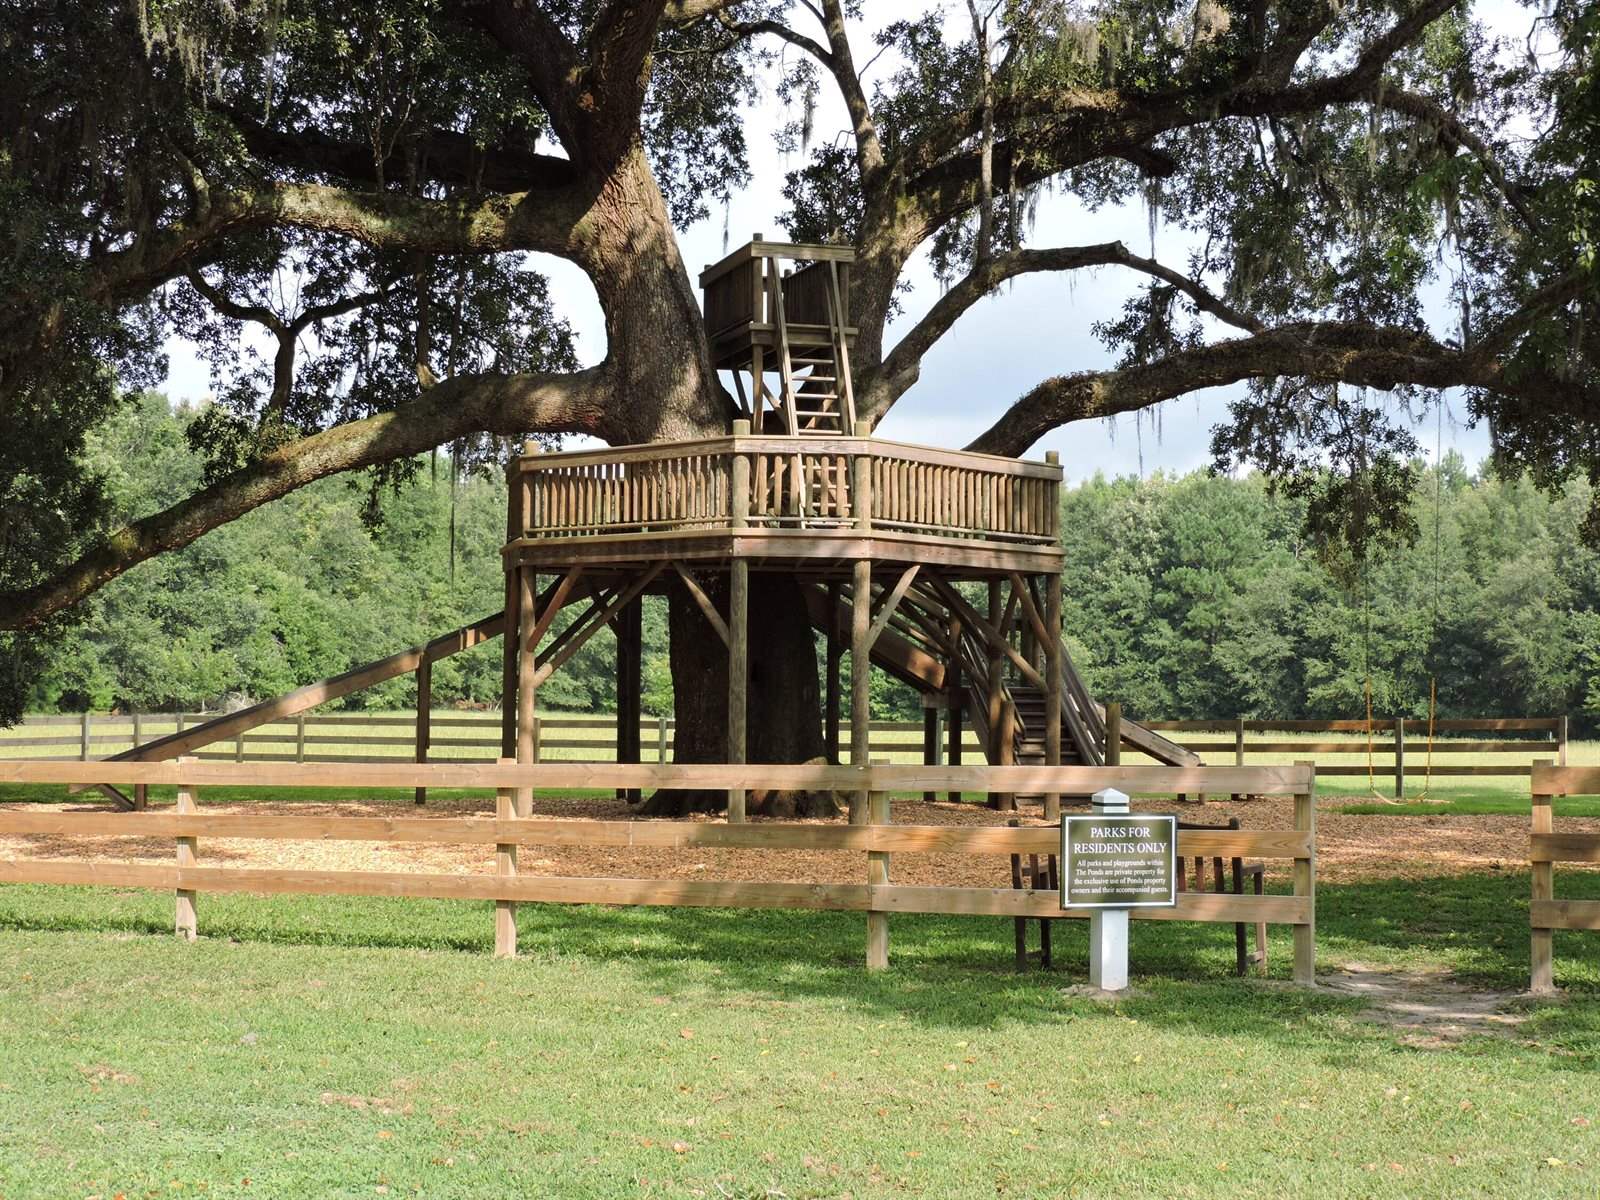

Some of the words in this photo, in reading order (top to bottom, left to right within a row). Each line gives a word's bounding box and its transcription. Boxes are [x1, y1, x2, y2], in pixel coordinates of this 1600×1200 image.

[1090, 827, 1126, 838] PARKS
[1128, 827, 1151, 838] FOR
[1074, 842, 1135, 854] RESIDENTS
[1136, 842, 1168, 853] ONLY
[1087, 860, 1102, 868] parks
[1113, 860, 1146, 868] playgrounds
[1114, 869, 1133, 877] private
[1143, 878, 1166, 886] property
[1091, 886, 1102, 894] and
